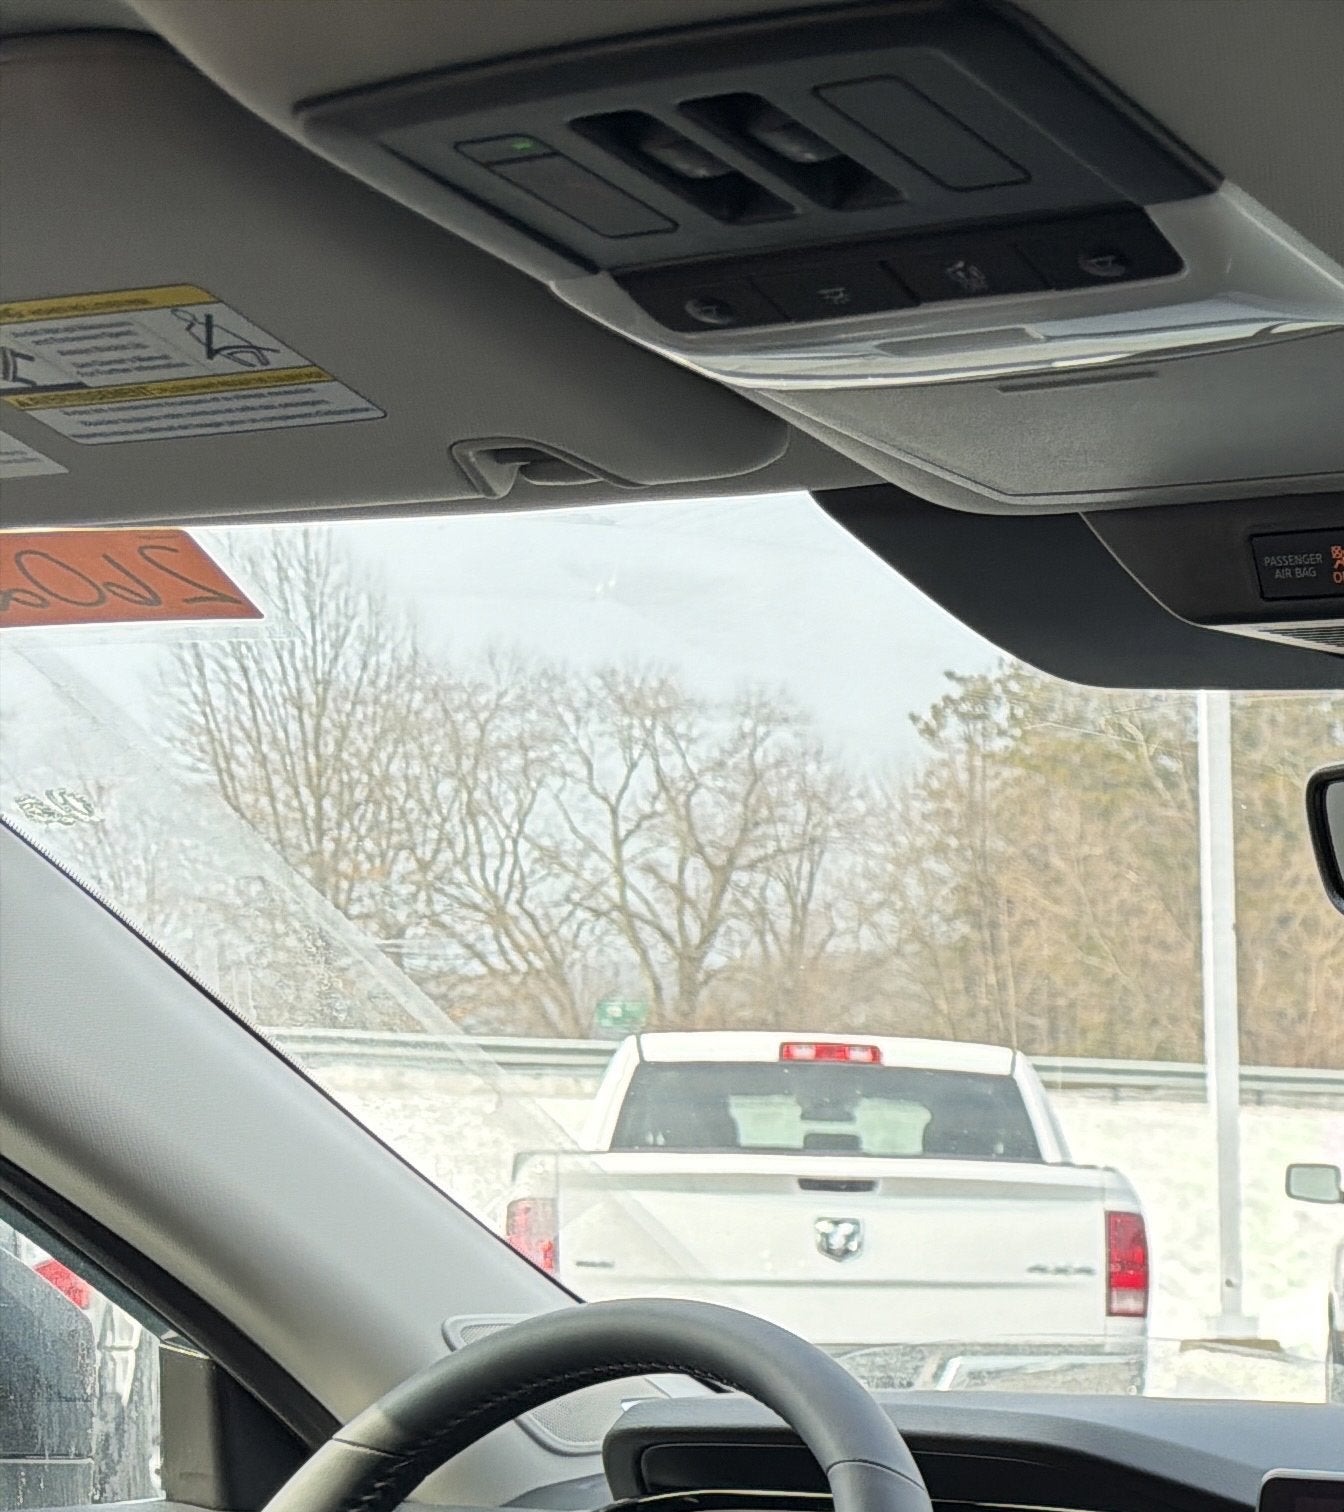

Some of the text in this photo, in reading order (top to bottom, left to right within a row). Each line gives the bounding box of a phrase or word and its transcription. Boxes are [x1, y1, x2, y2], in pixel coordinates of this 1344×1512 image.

[1263, 552, 1323, 567] PASSENGER
[1274, 565, 1317, 579] AIR BAG
